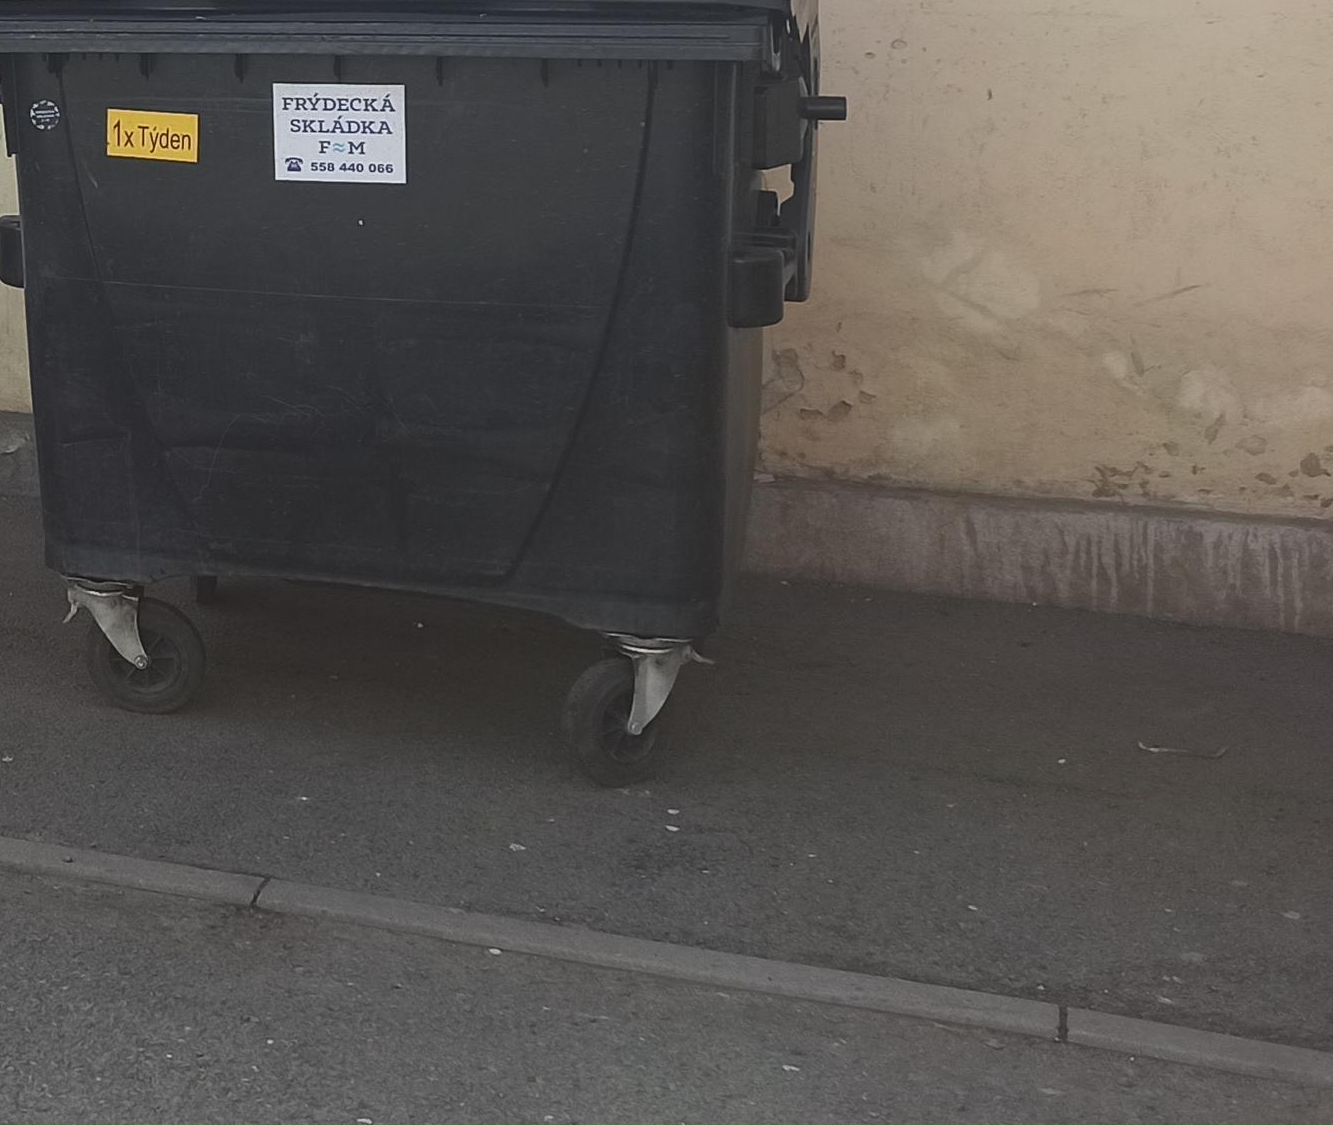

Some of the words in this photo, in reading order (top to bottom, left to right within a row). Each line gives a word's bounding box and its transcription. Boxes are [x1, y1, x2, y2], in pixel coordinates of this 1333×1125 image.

[281, 93, 396, 113] FRÝDECKÁ
[290, 117, 393, 135] SKLÁDKA
[113, 120, 134, 148] 1x
[138, 125, 191, 153] Týden
[310, 162, 334, 172] 558
[339, 162, 364, 173] 440
[368, 163, 394, 174] 066
